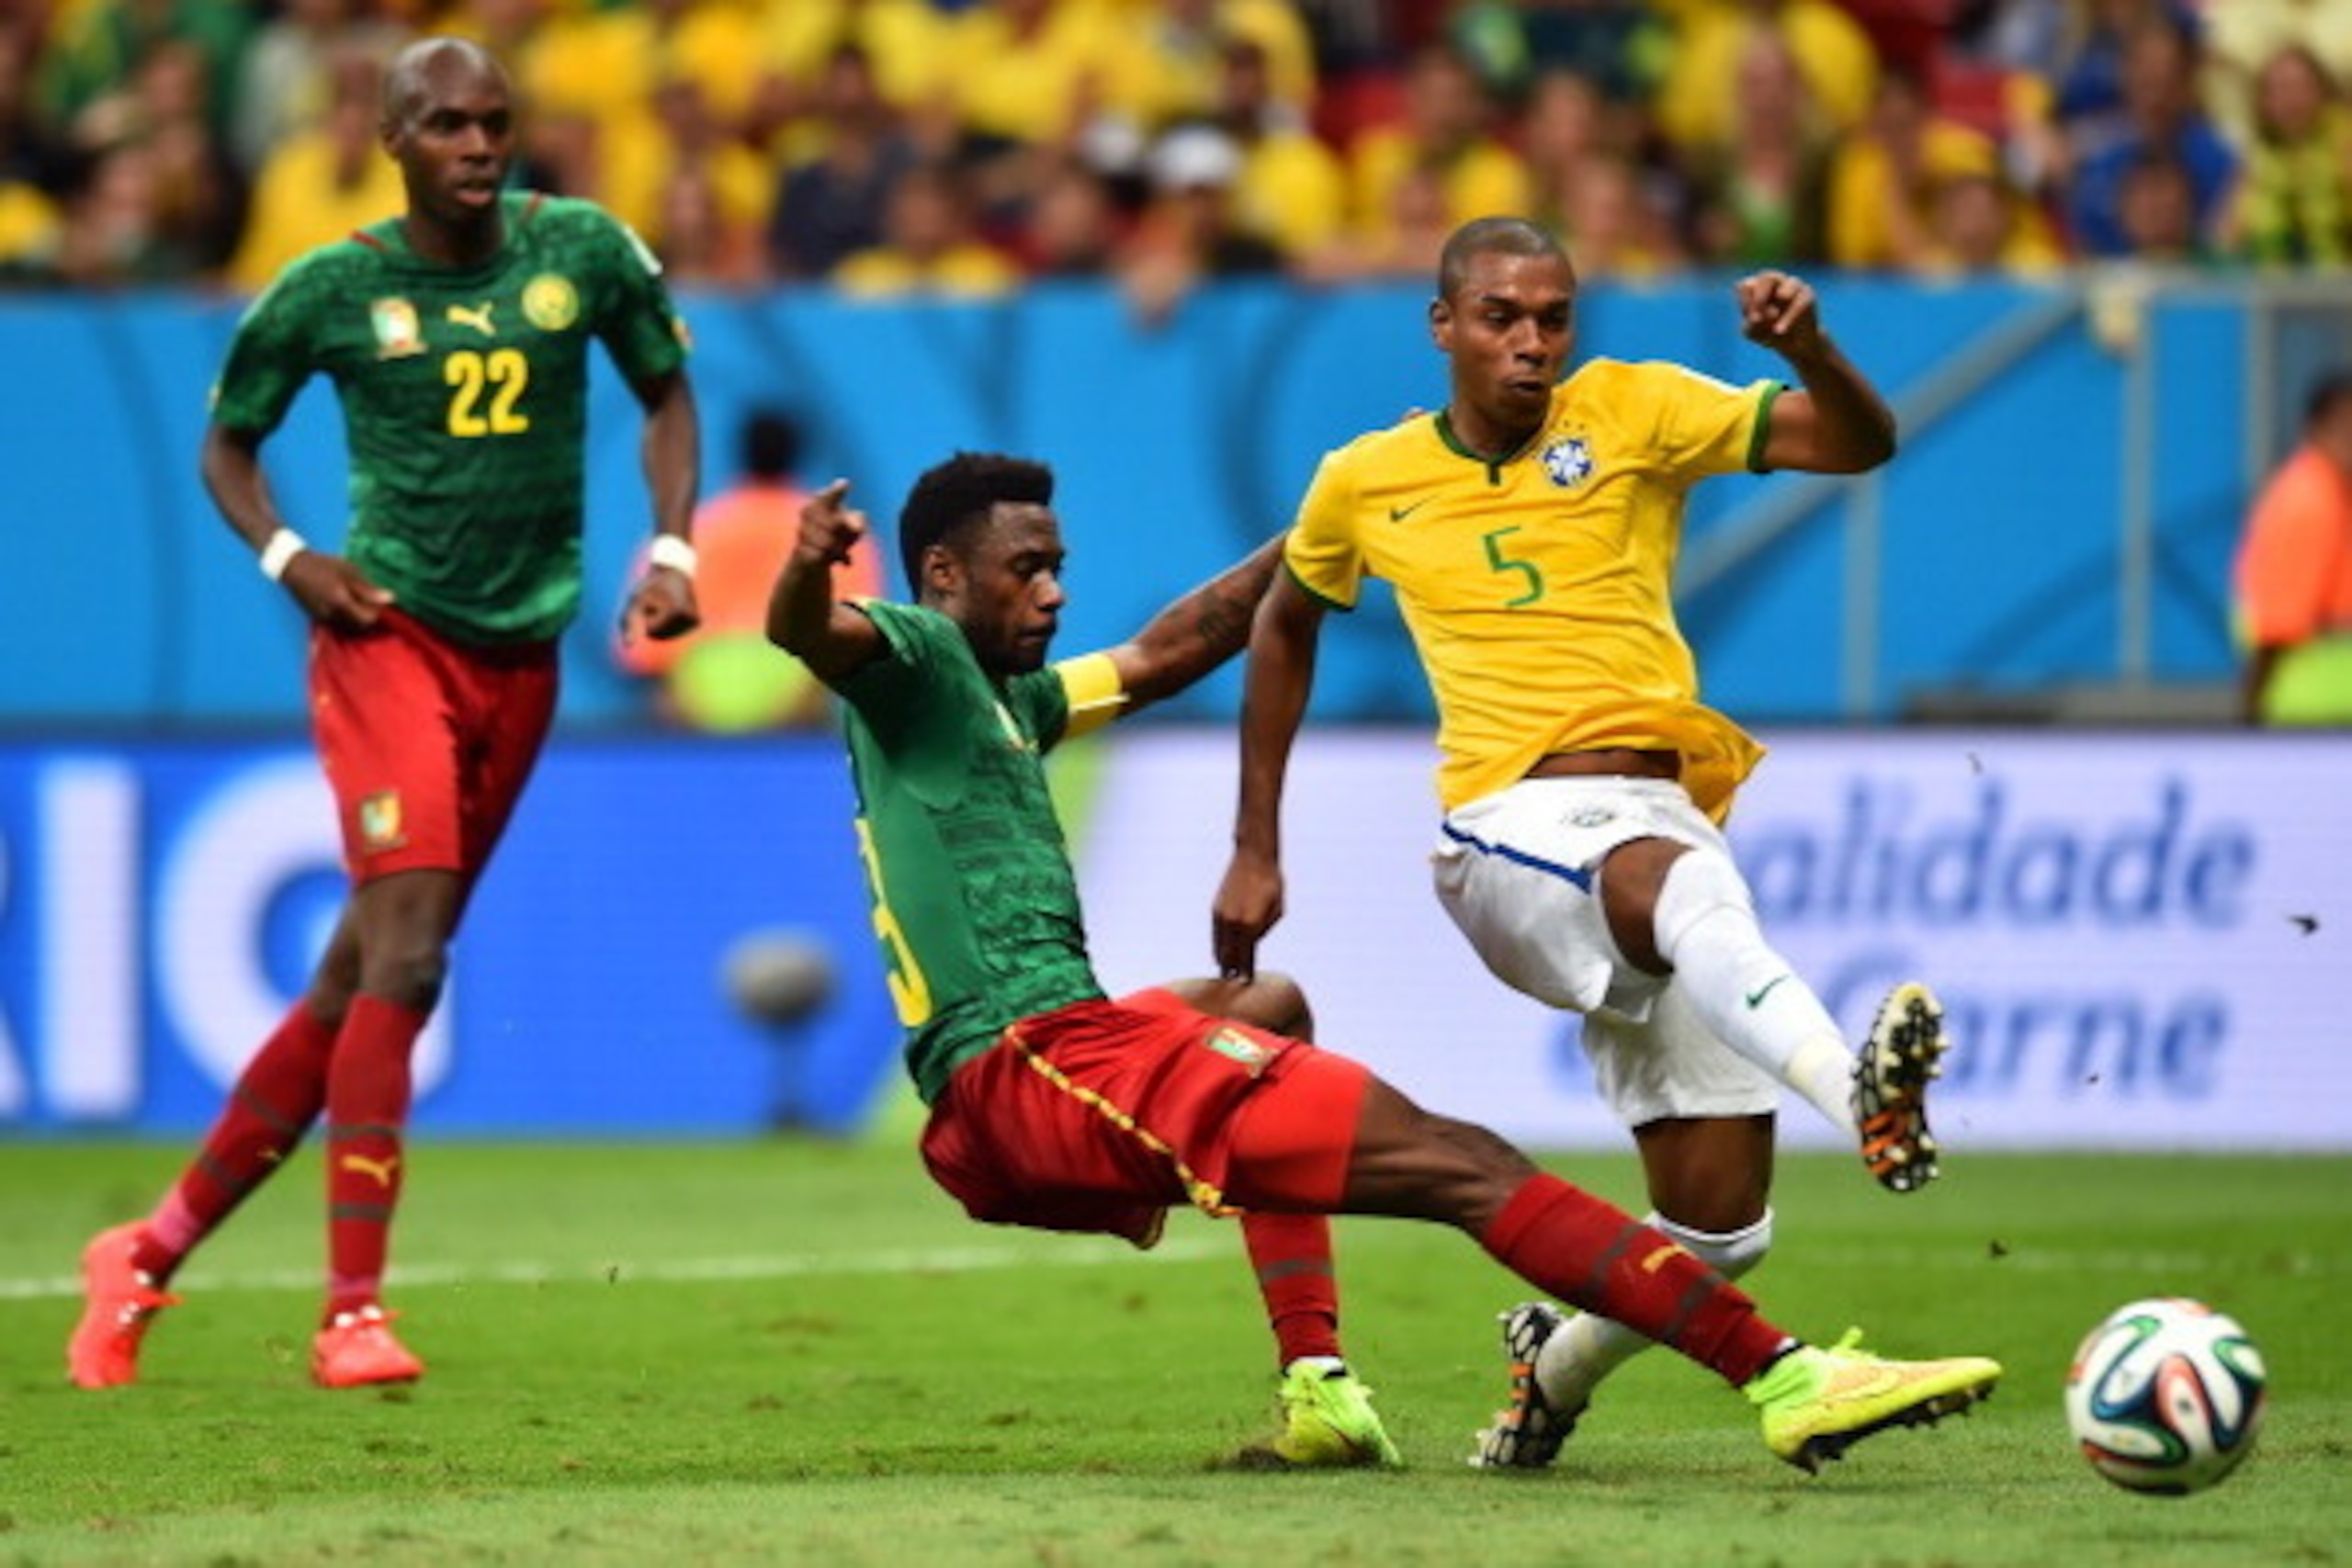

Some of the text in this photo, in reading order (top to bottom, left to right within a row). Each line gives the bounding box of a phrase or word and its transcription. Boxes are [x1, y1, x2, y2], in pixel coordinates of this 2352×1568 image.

[445, 348, 529, 438] 22
[1483, 524, 1544, 608] 5
[1736, 776, 2256, 926] alidade
[0, 751, 453, 1115] IO
